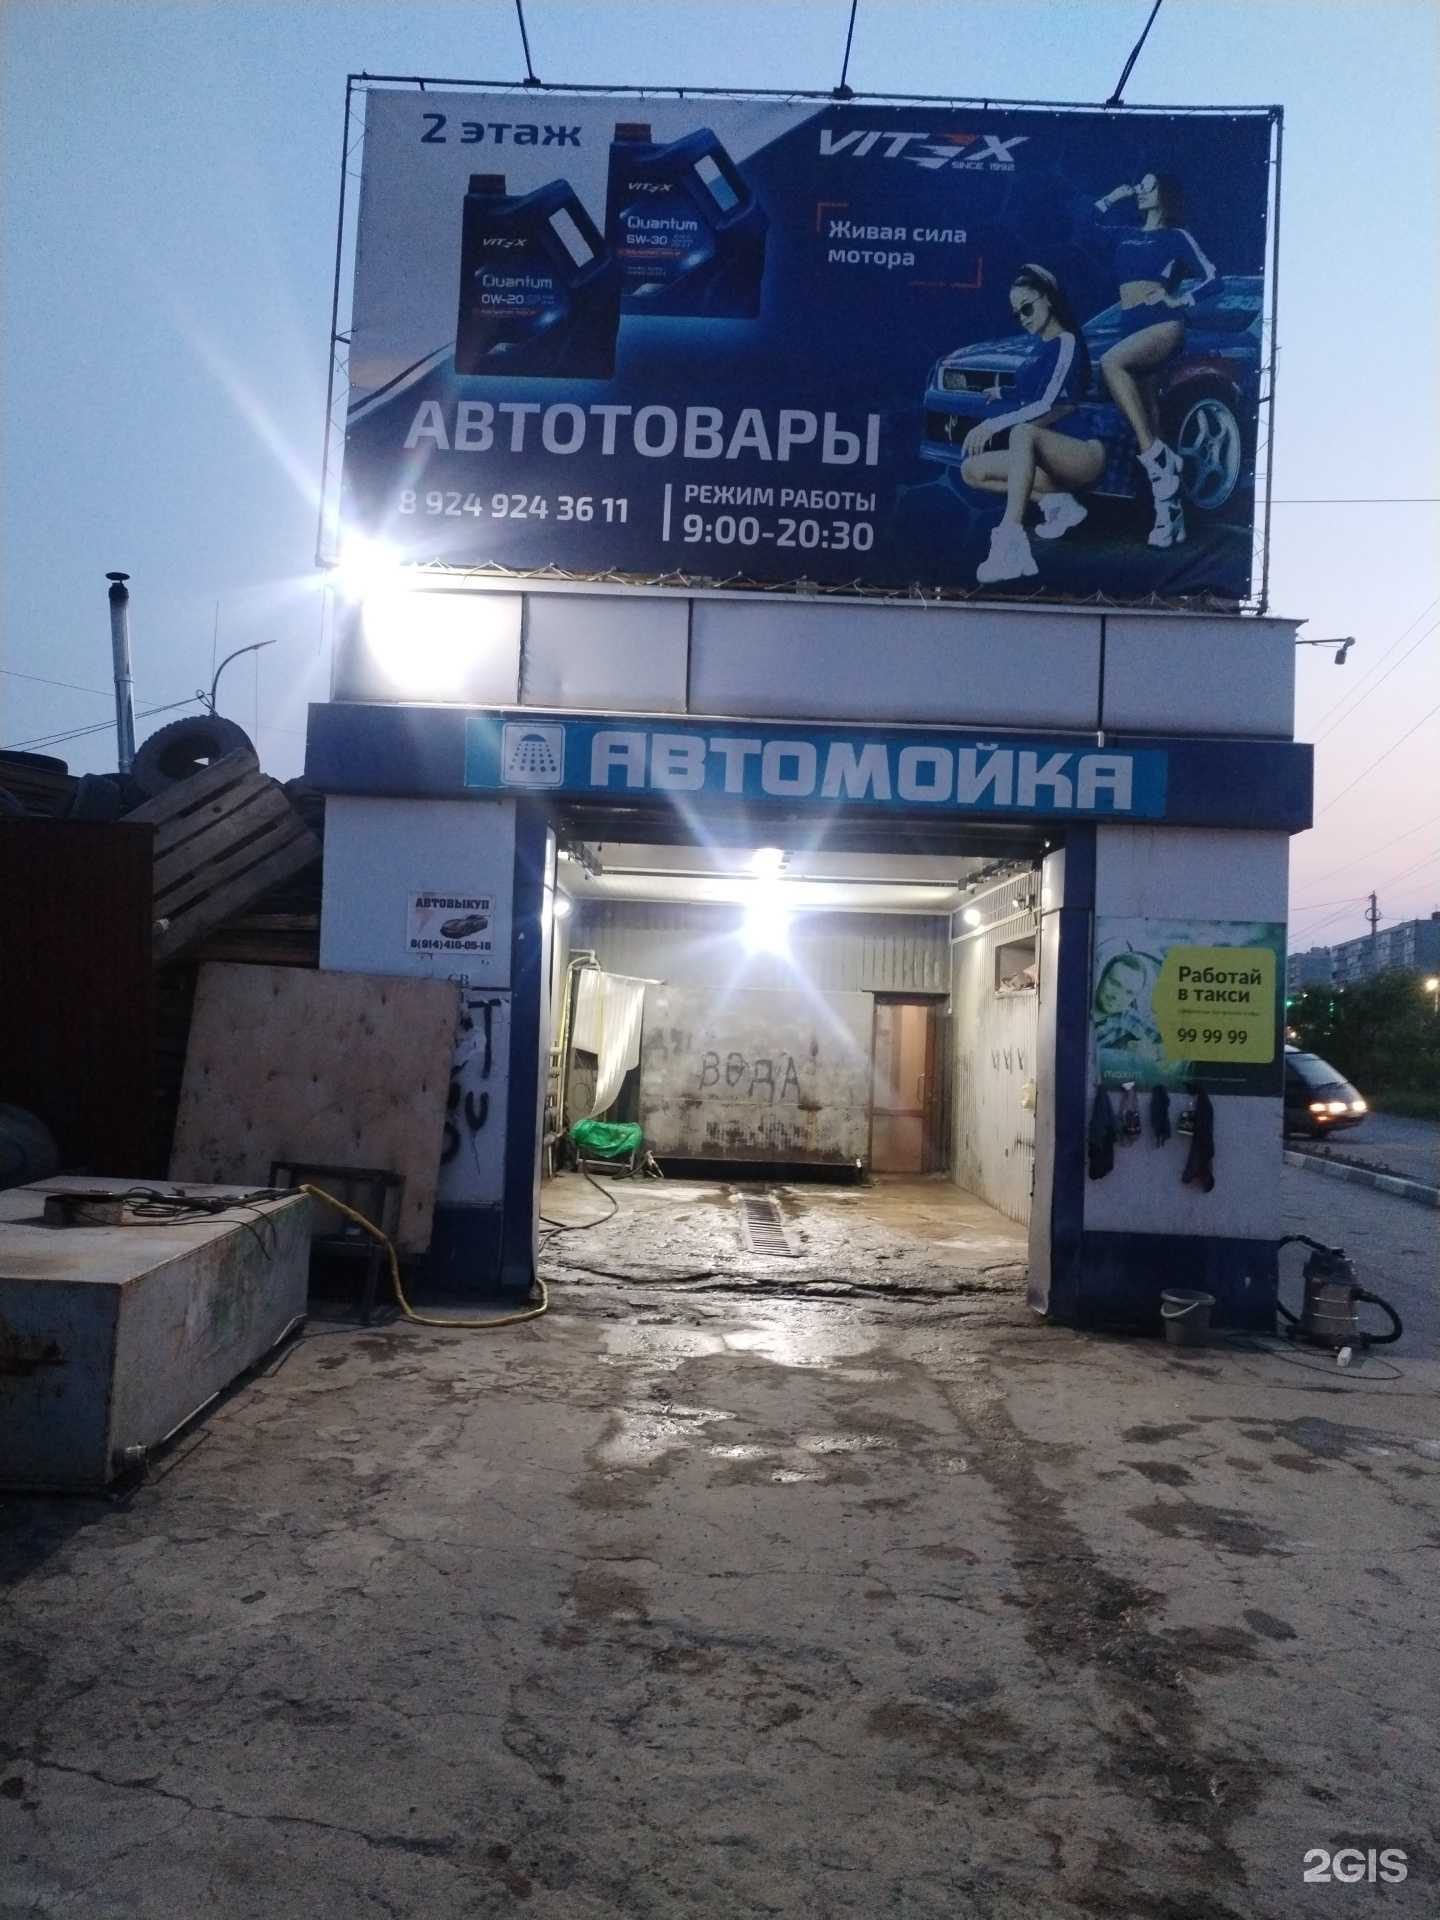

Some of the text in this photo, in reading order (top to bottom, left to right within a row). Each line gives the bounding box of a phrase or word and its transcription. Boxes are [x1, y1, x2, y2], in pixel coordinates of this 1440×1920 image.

[421, 113, 581, 147] 2 этаж
[951, 160, 1016, 172] SINCE 1992
[626, 215, 699, 231] Quantum
[828, 220, 967, 244] Живая сила
[625, 234, 669, 246] 5W-30
[827, 249, 915, 270] мотора
[482, 274, 553, 289] Quantum
[481, 293, 525, 305] 0W-20
[403, 400, 881, 467] АВТОТОВАРЫ
[398, 489, 628, 523] 8 924 924 36 11
[684, 484, 876, 512] РЕЖИМ РАБОТЫ
[683, 514, 875, 551] 9:00-20:30
[590, 730, 1134, 810] АВТОМОЙКА
[415, 897, 490, 910] АВТОВЫКУП
[1178, 965, 1262, 985] Работай
[1178, 988, 1250, 1003] в такси
[1177, 1027, 1248, 1045] 99 99 99
